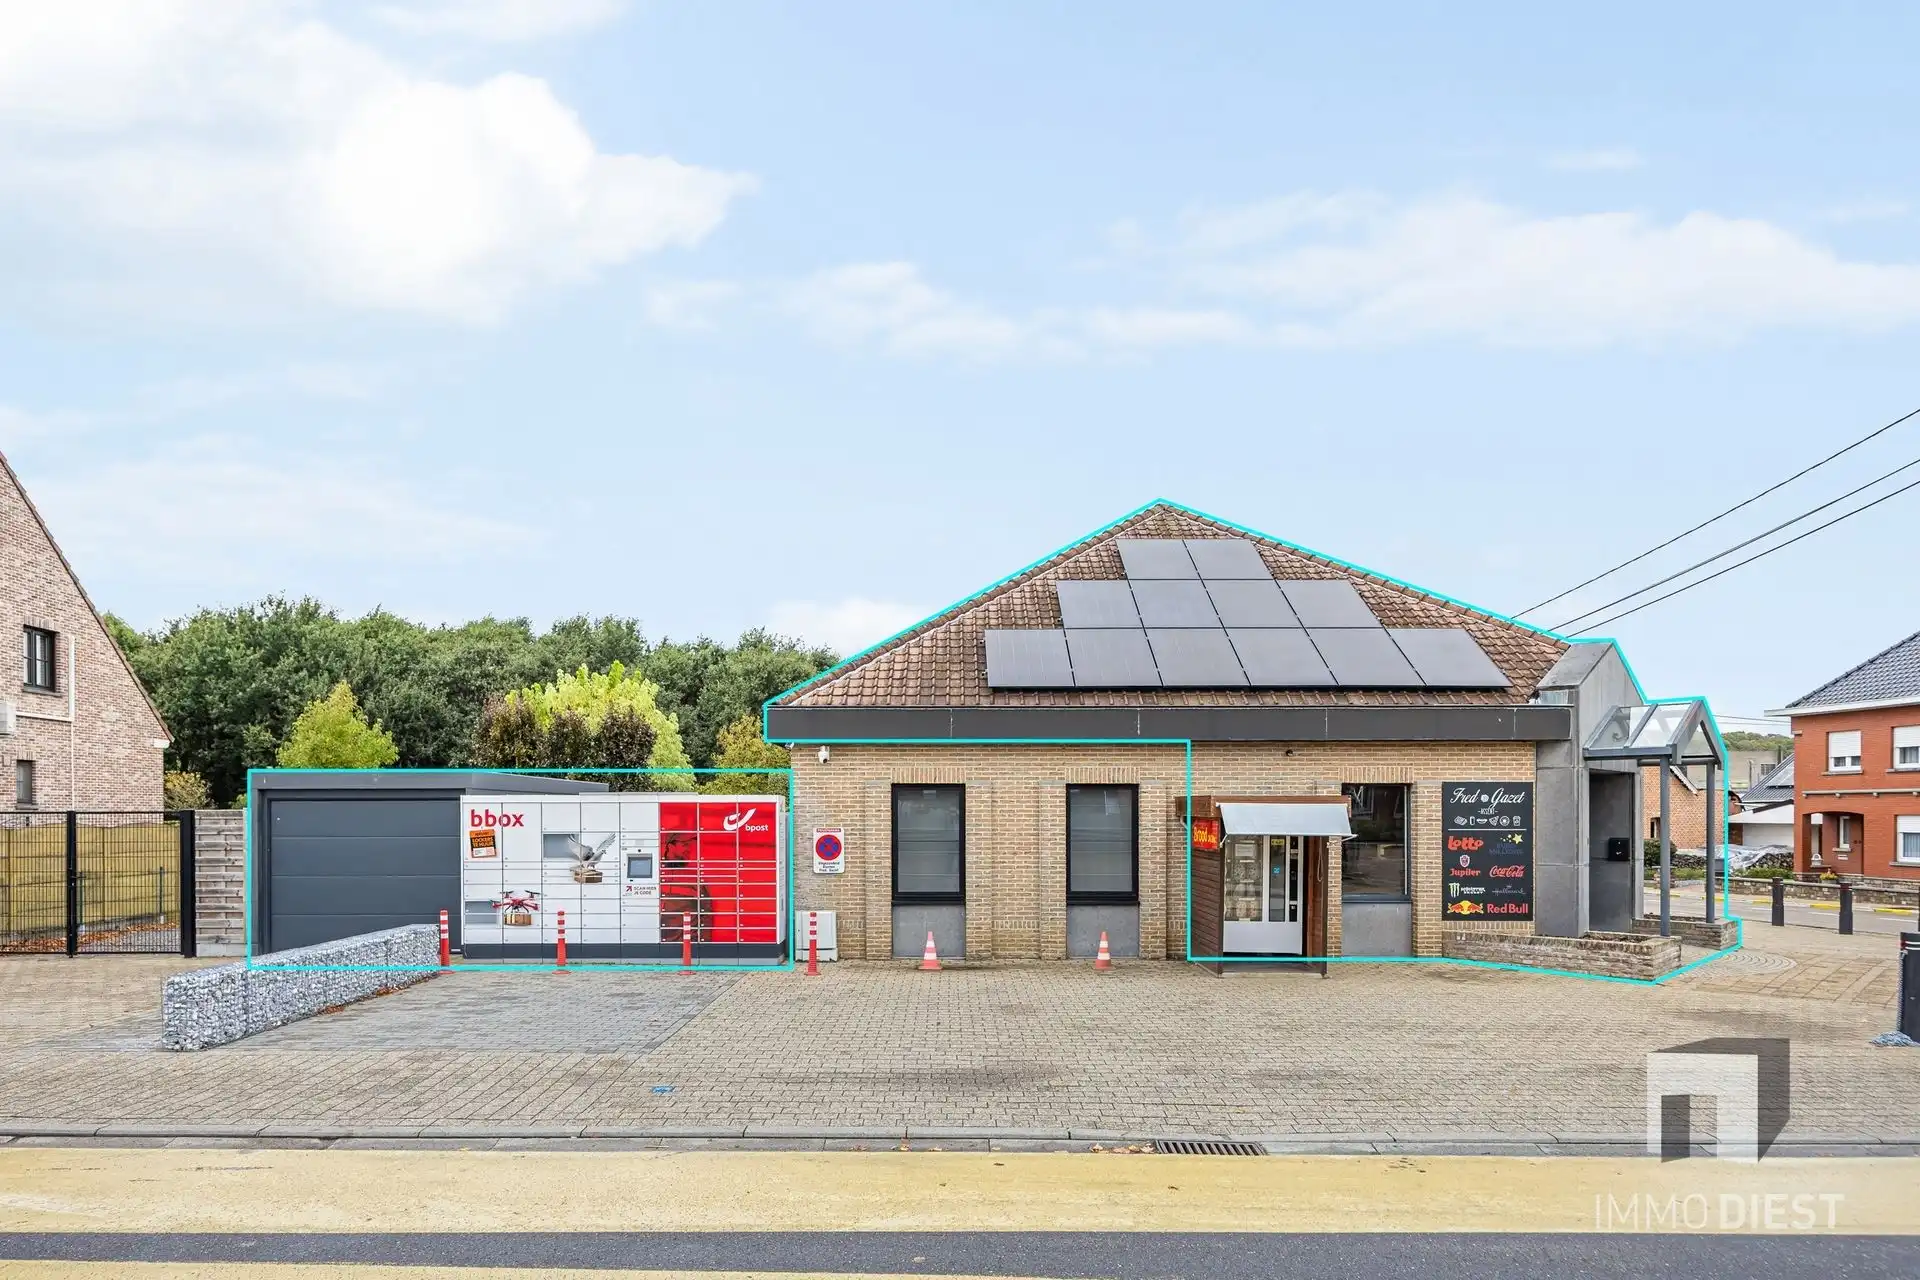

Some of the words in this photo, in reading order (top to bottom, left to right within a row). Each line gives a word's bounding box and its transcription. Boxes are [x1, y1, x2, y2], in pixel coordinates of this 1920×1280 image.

[1450, 788, 1480, 803] Fred
[1488, 788, 1525, 811] Gazet
[471, 809, 524, 827] bbox
[745, 823, 768, 832] bpost
[1449, 868, 1481, 877] Jupiler
[1487, 904, 1507, 913] Red
[1508, 904, 1528, 913] Bull
